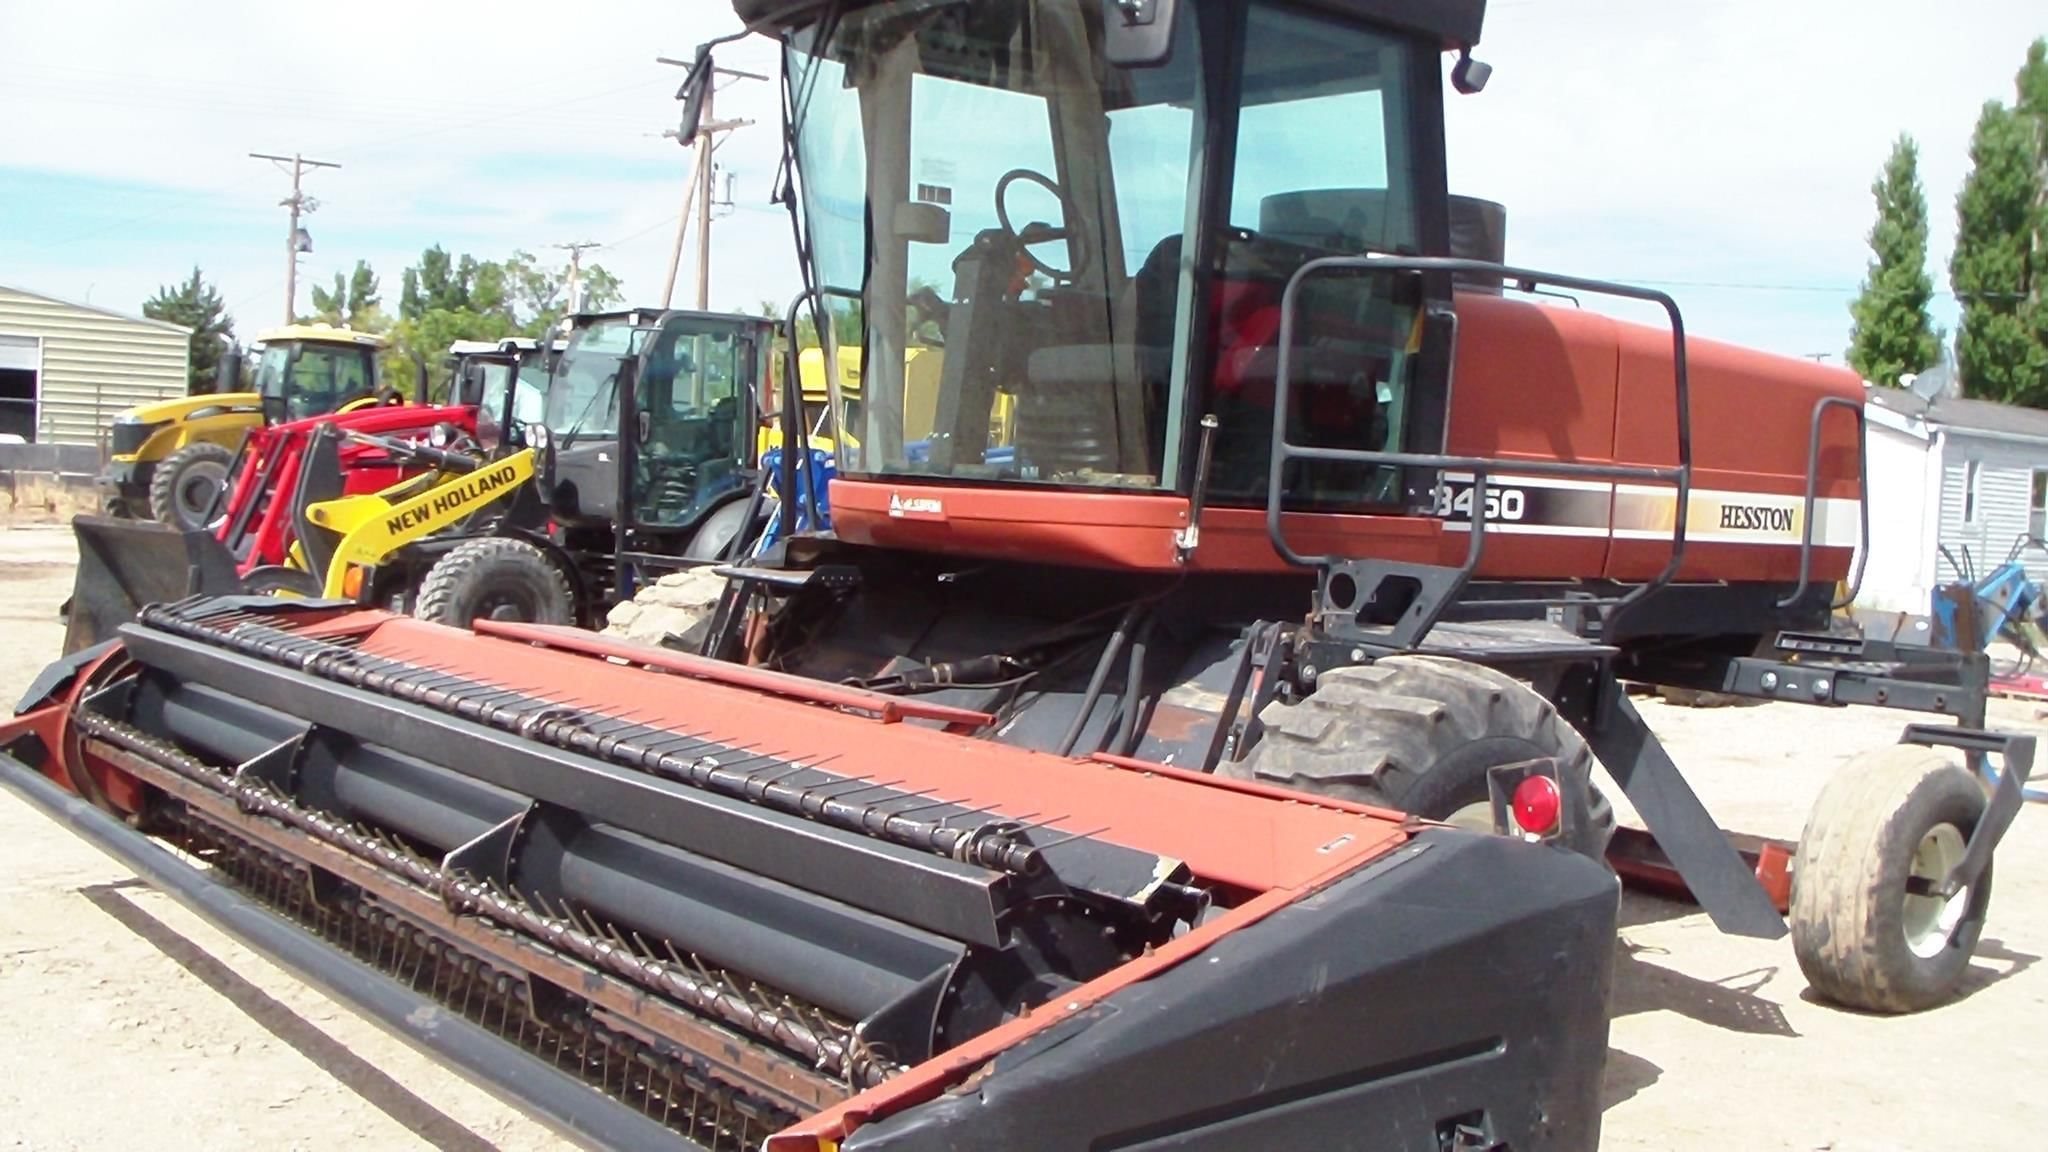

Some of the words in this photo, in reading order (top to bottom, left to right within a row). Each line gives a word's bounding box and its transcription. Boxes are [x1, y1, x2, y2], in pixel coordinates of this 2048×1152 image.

[387, 502, 431, 535] NEW
[433, 465, 517, 514] HOLLAND
[1719, 504, 1794, 531] HESSTON
